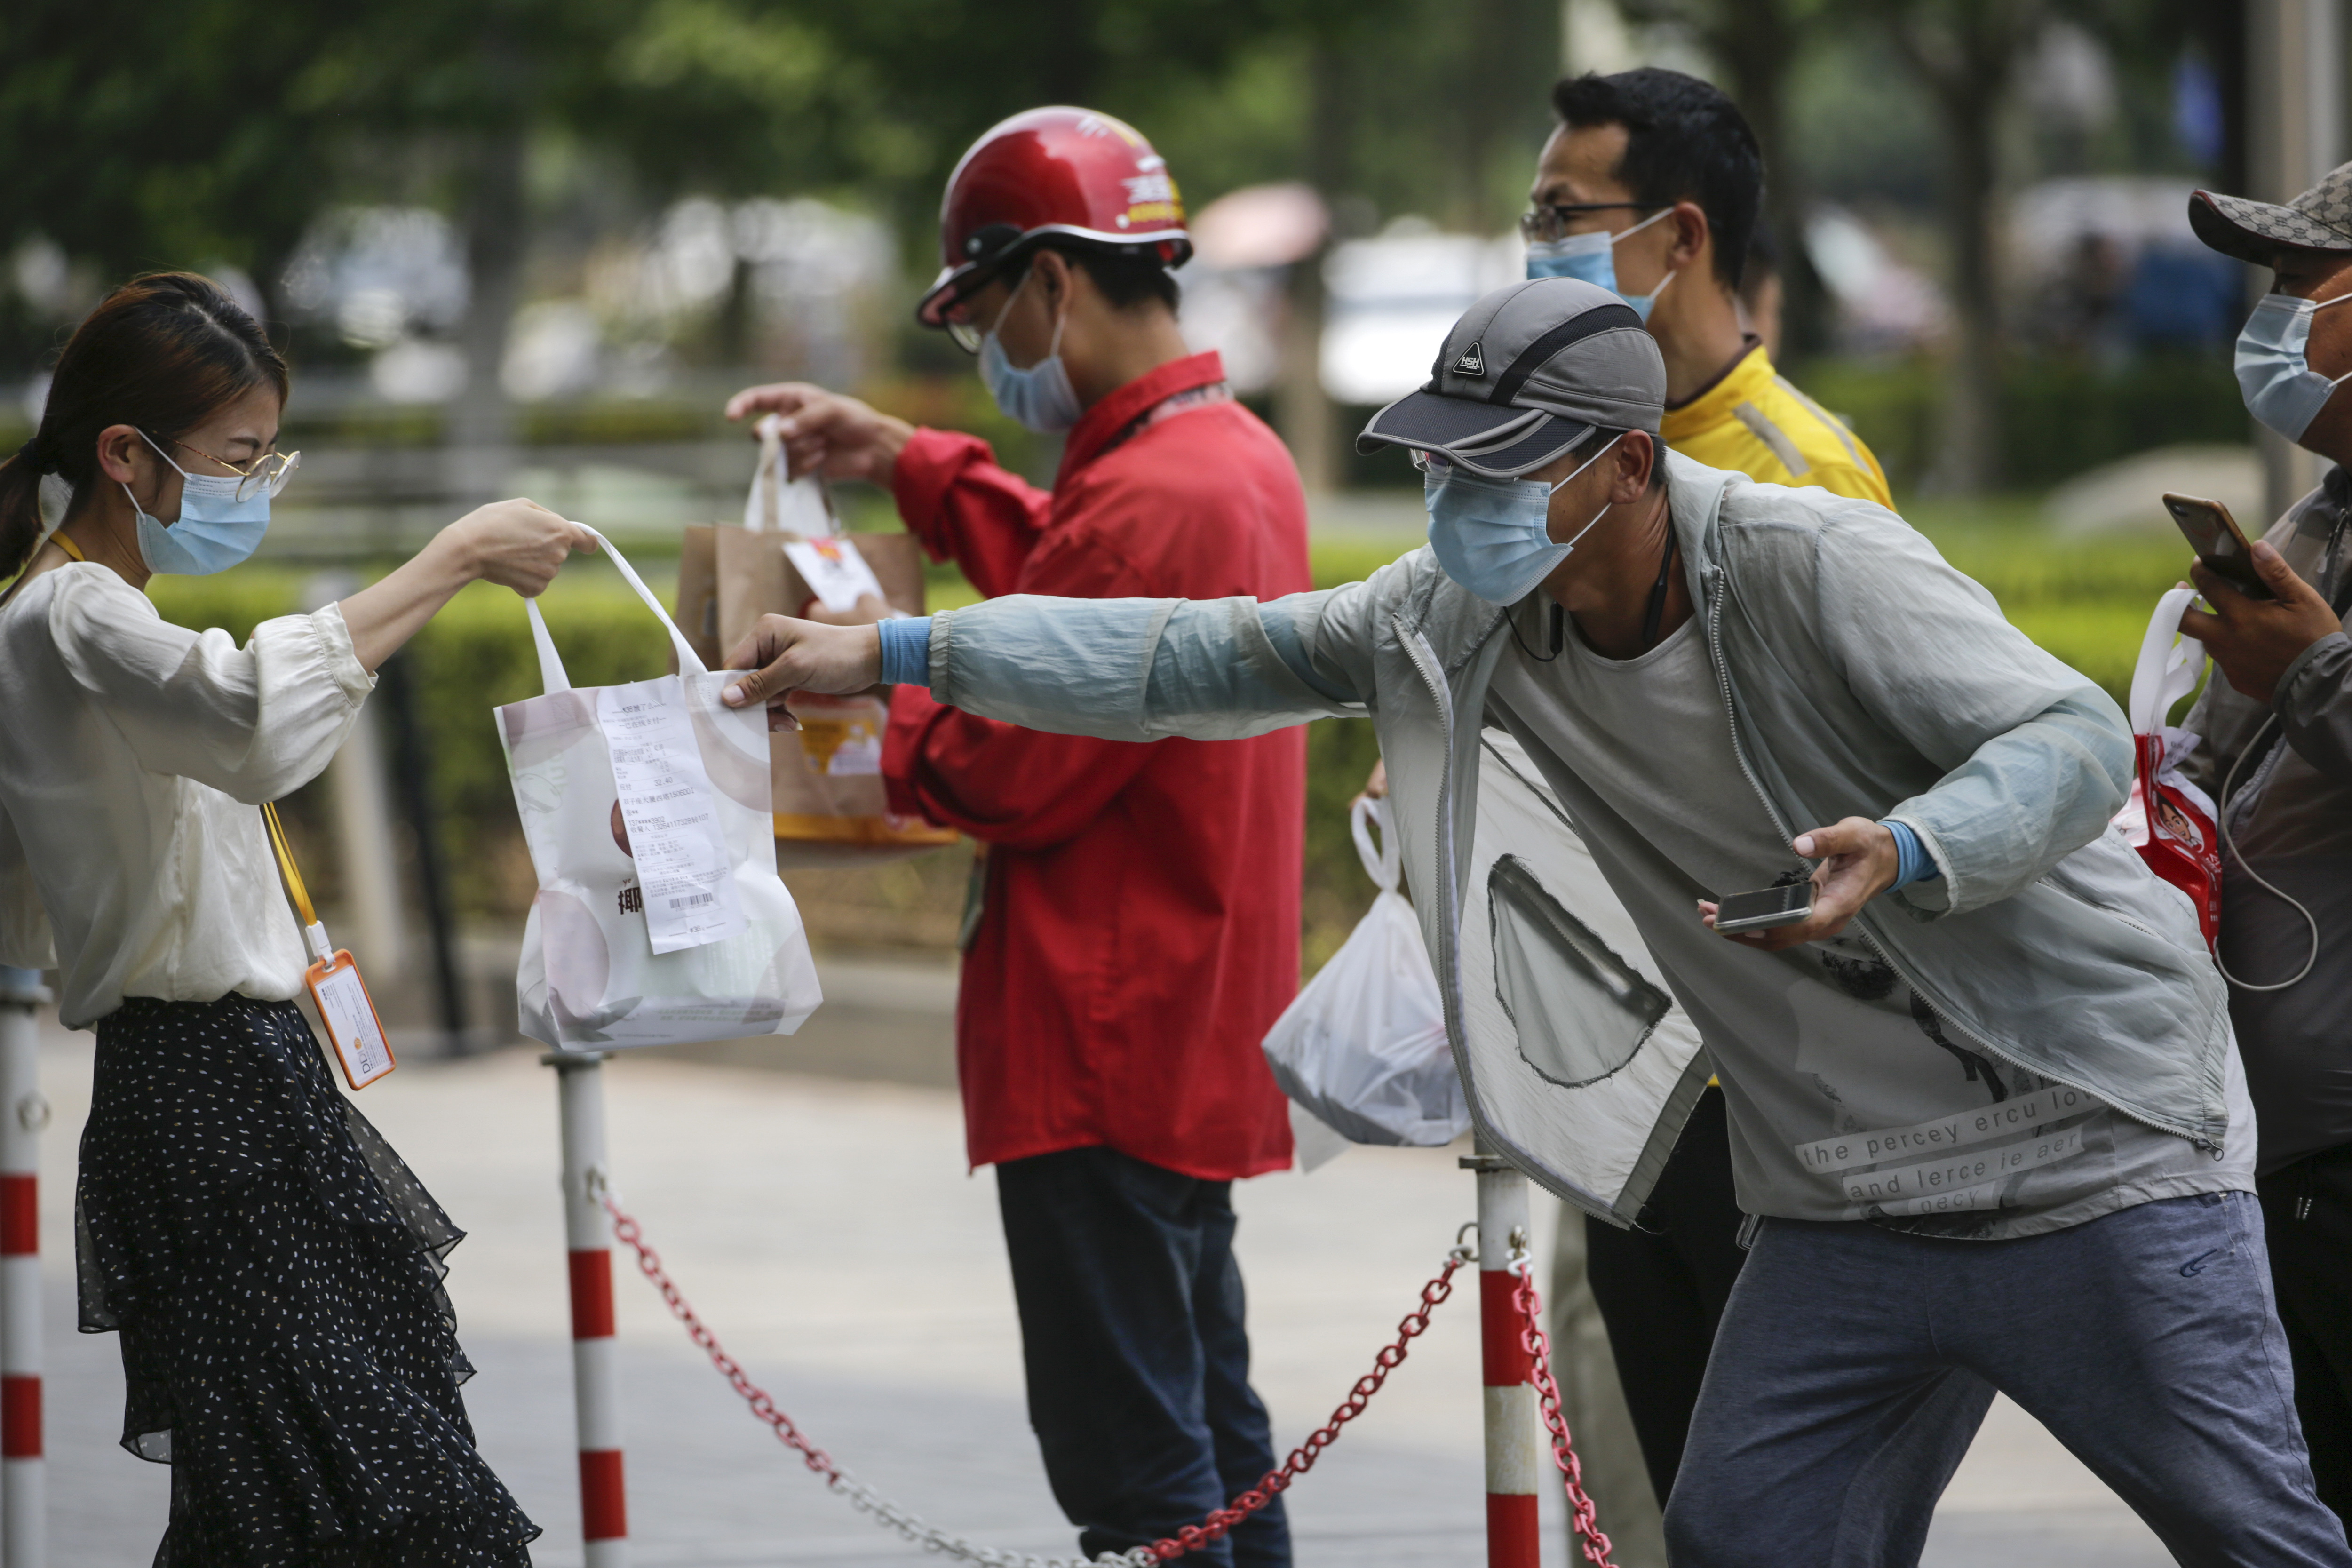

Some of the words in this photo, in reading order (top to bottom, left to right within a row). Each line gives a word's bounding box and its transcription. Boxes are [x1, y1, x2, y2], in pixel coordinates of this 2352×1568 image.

[1461, 357, 1480, 366] HSH
[654, 777, 673, 786] 32.40
[1803, 1145, 1849, 1167] the
[1867, 1123, 1958, 1158] percey
[1975, 1102, 2036, 1132] ercu
[1850, 1175, 1901, 1199] and
[2001, 1151, 2022, 1170] ie
[2037, 1133, 2077, 1159] aer
